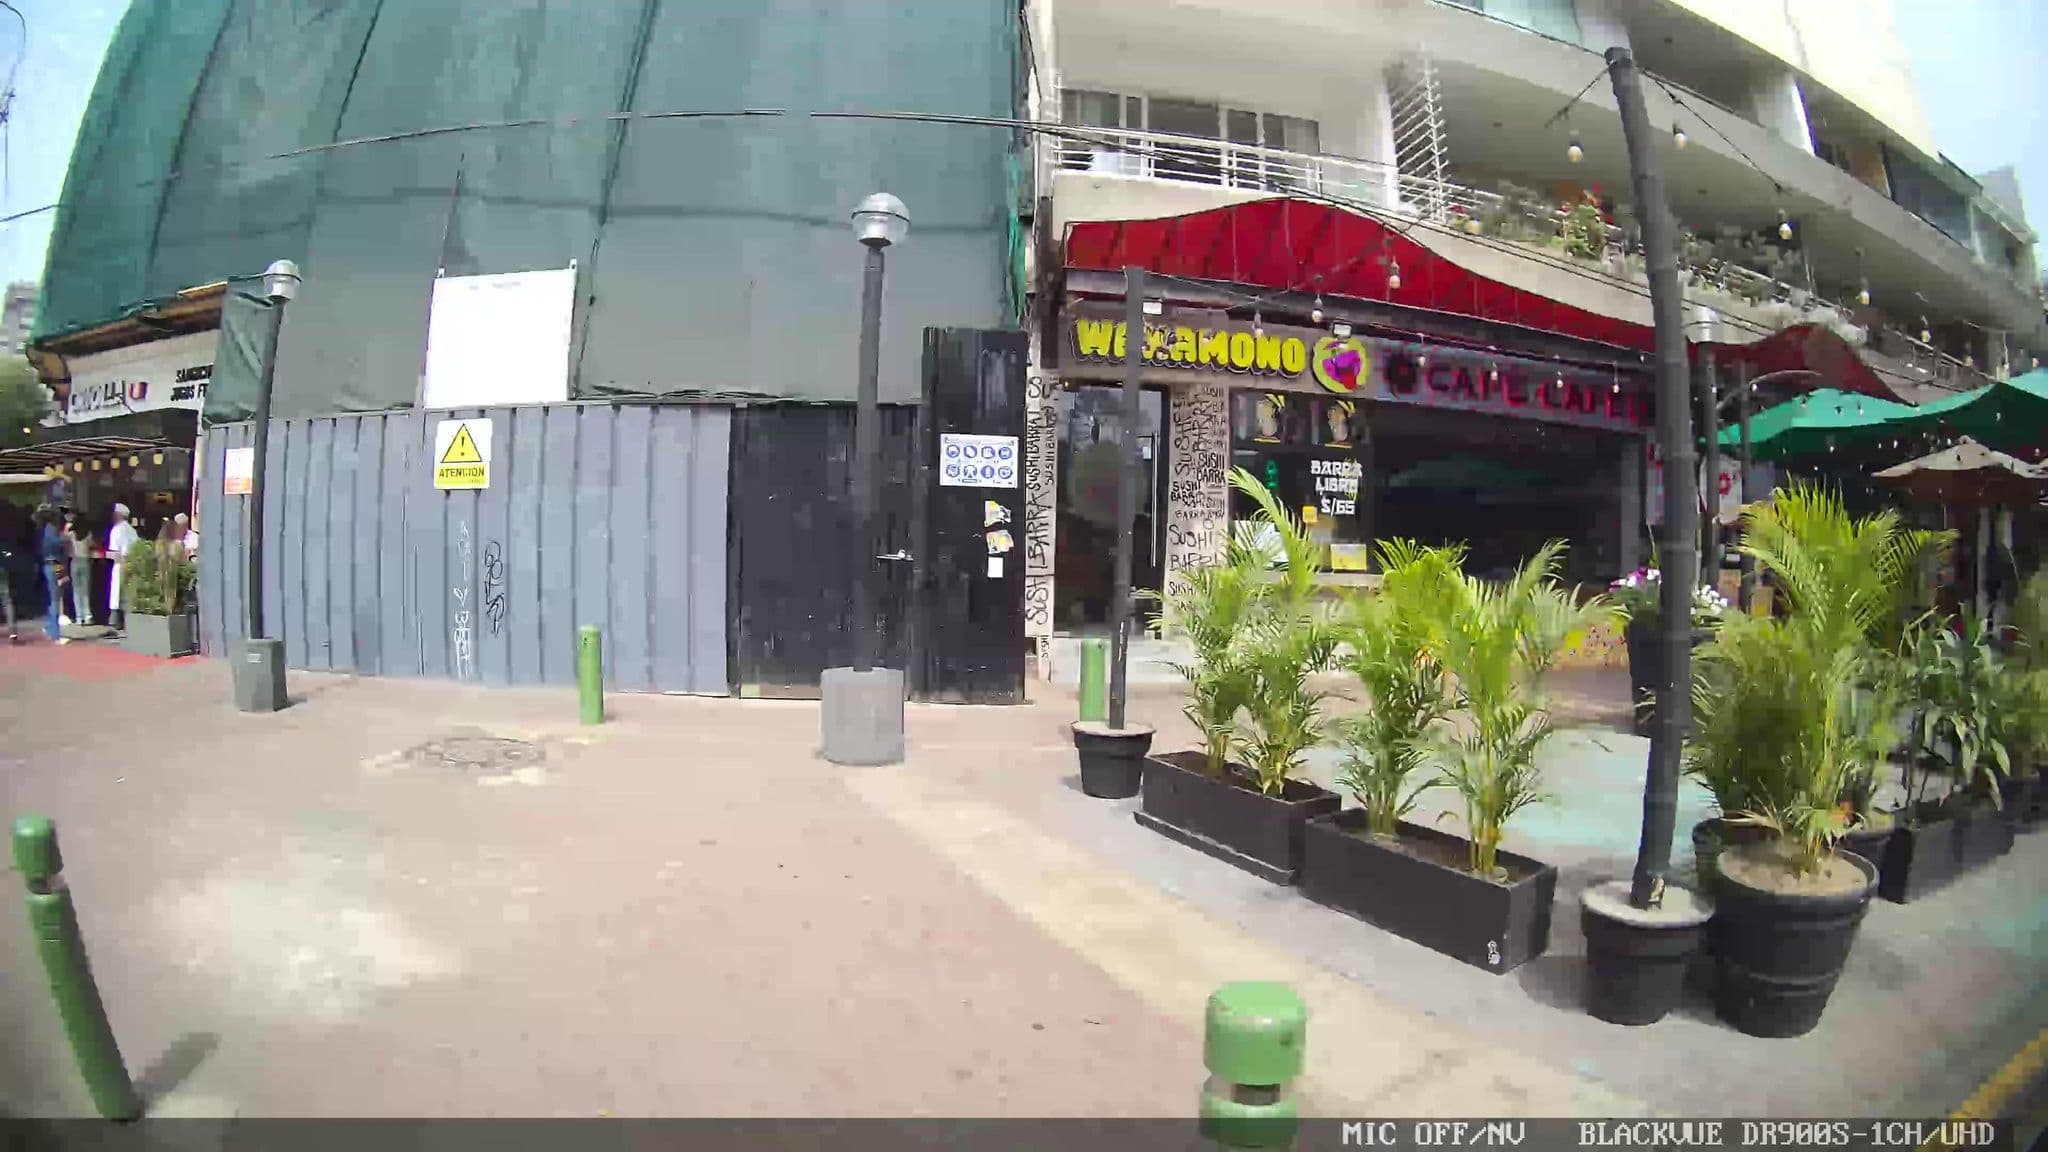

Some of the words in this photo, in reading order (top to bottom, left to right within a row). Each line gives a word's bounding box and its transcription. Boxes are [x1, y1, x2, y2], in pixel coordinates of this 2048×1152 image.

[1311, 459, 1362, 478] BARRA
[1172, 480, 1201, 492] SUSHI
[1169, 524, 1213, 550] SUSHI
